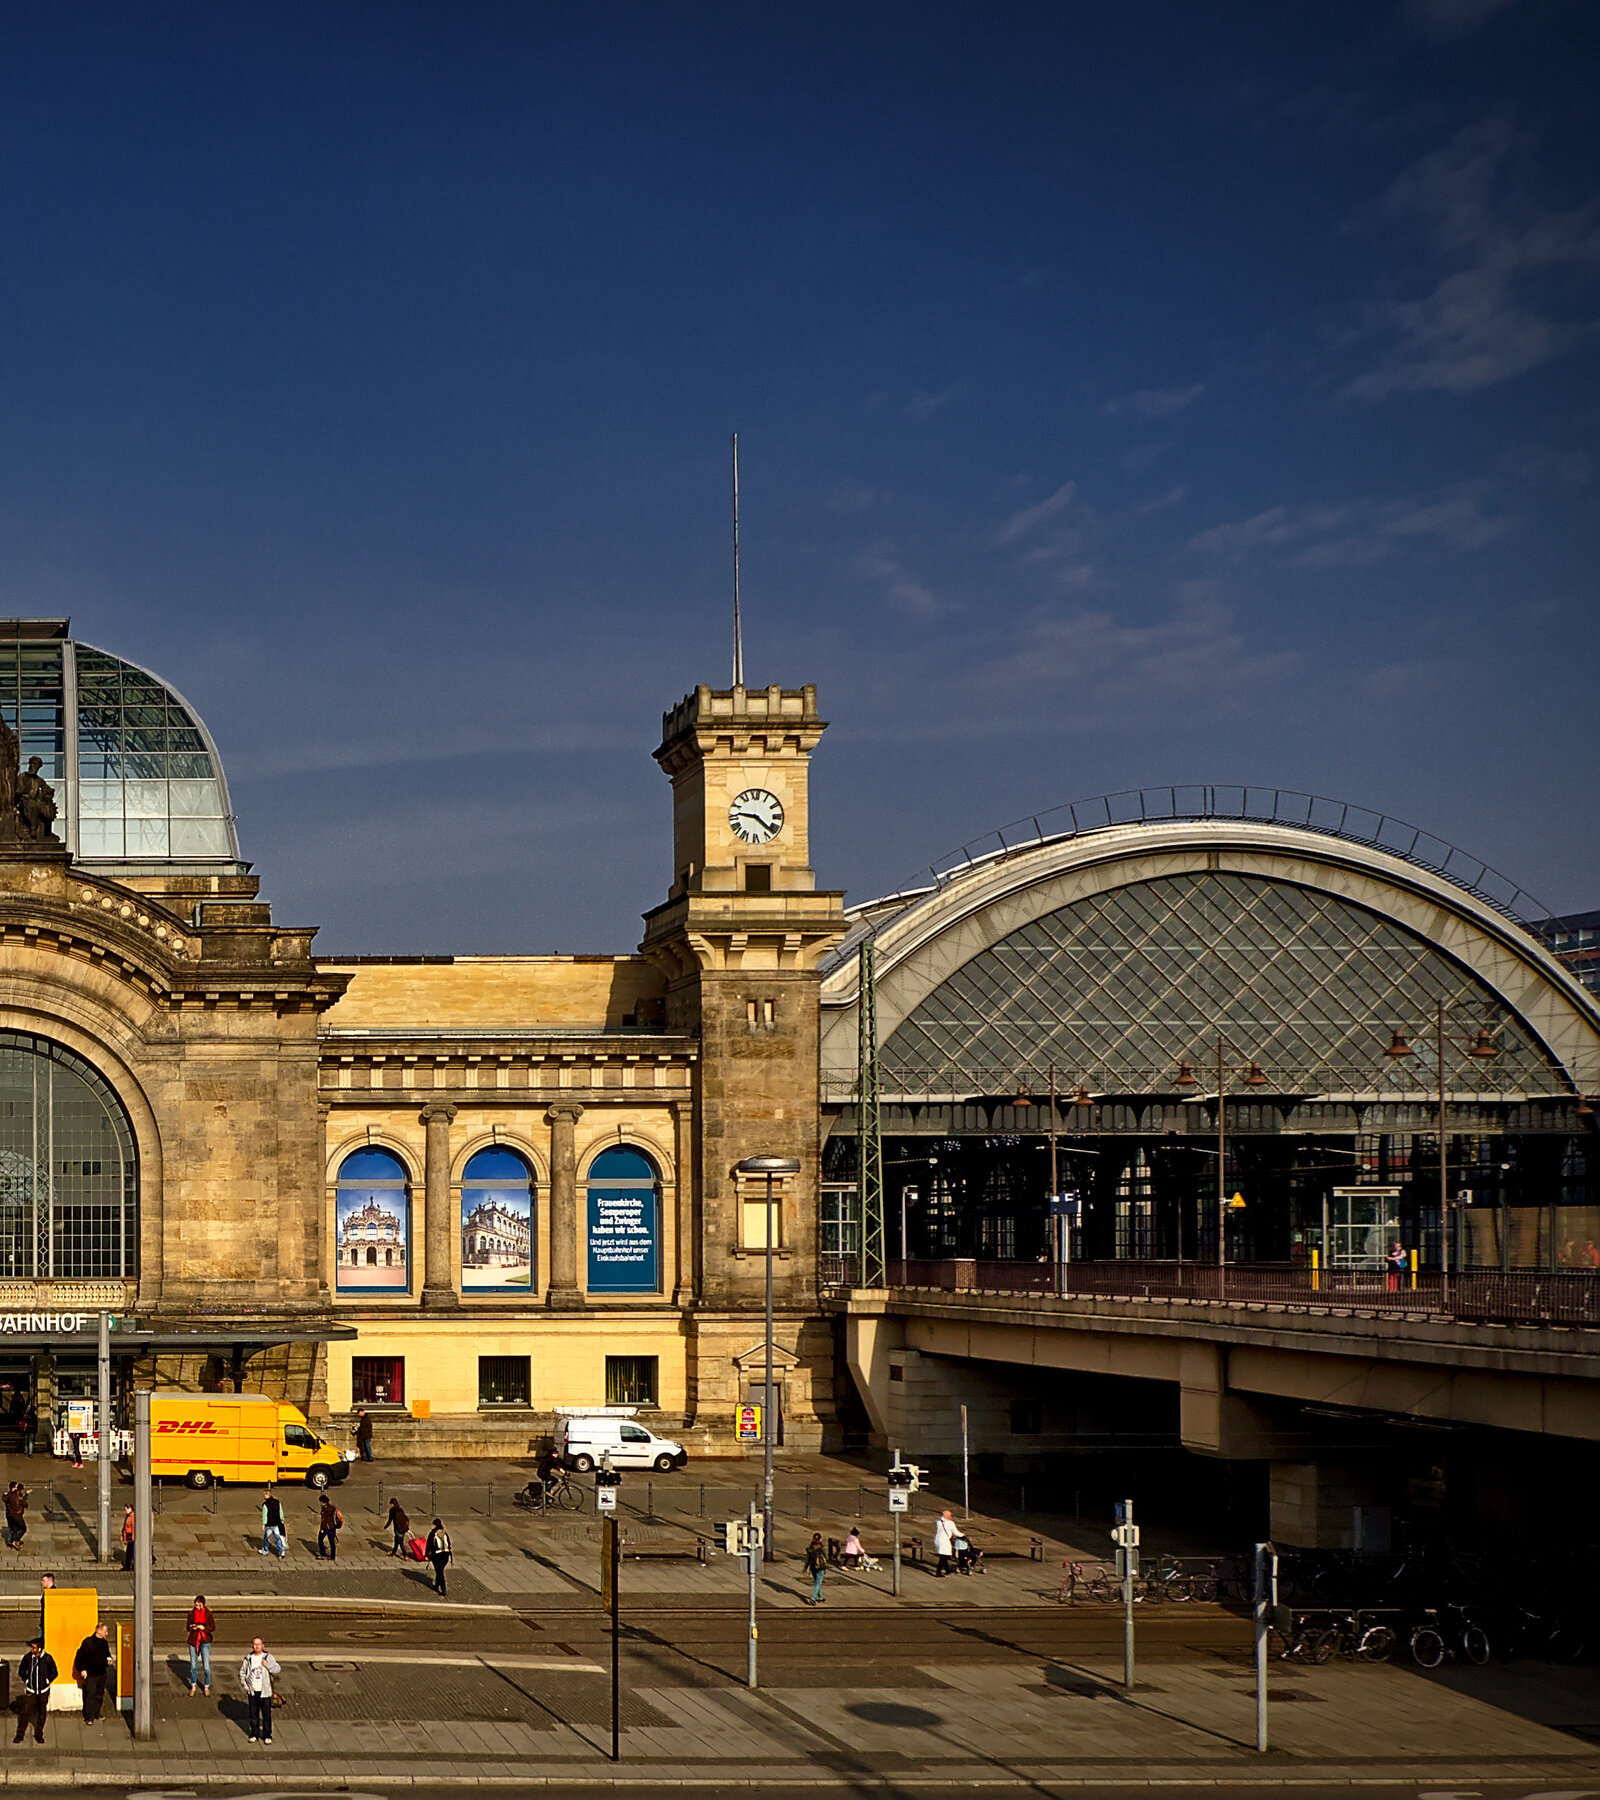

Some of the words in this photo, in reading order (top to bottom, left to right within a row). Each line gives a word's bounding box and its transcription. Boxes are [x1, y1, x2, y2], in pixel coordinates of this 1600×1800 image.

[597, 1198, 644, 1208] Frauenkirche,
[599, 1208, 641, 1217] Semperoper
[599, 1217, 613, 1225] und
[614, 1217, 641, 1226] Zwinger
[592, 1226, 614, 1234] haben
[615, 1226, 626, 1234] wir
[156, 1420, 218, 1434] DHL
